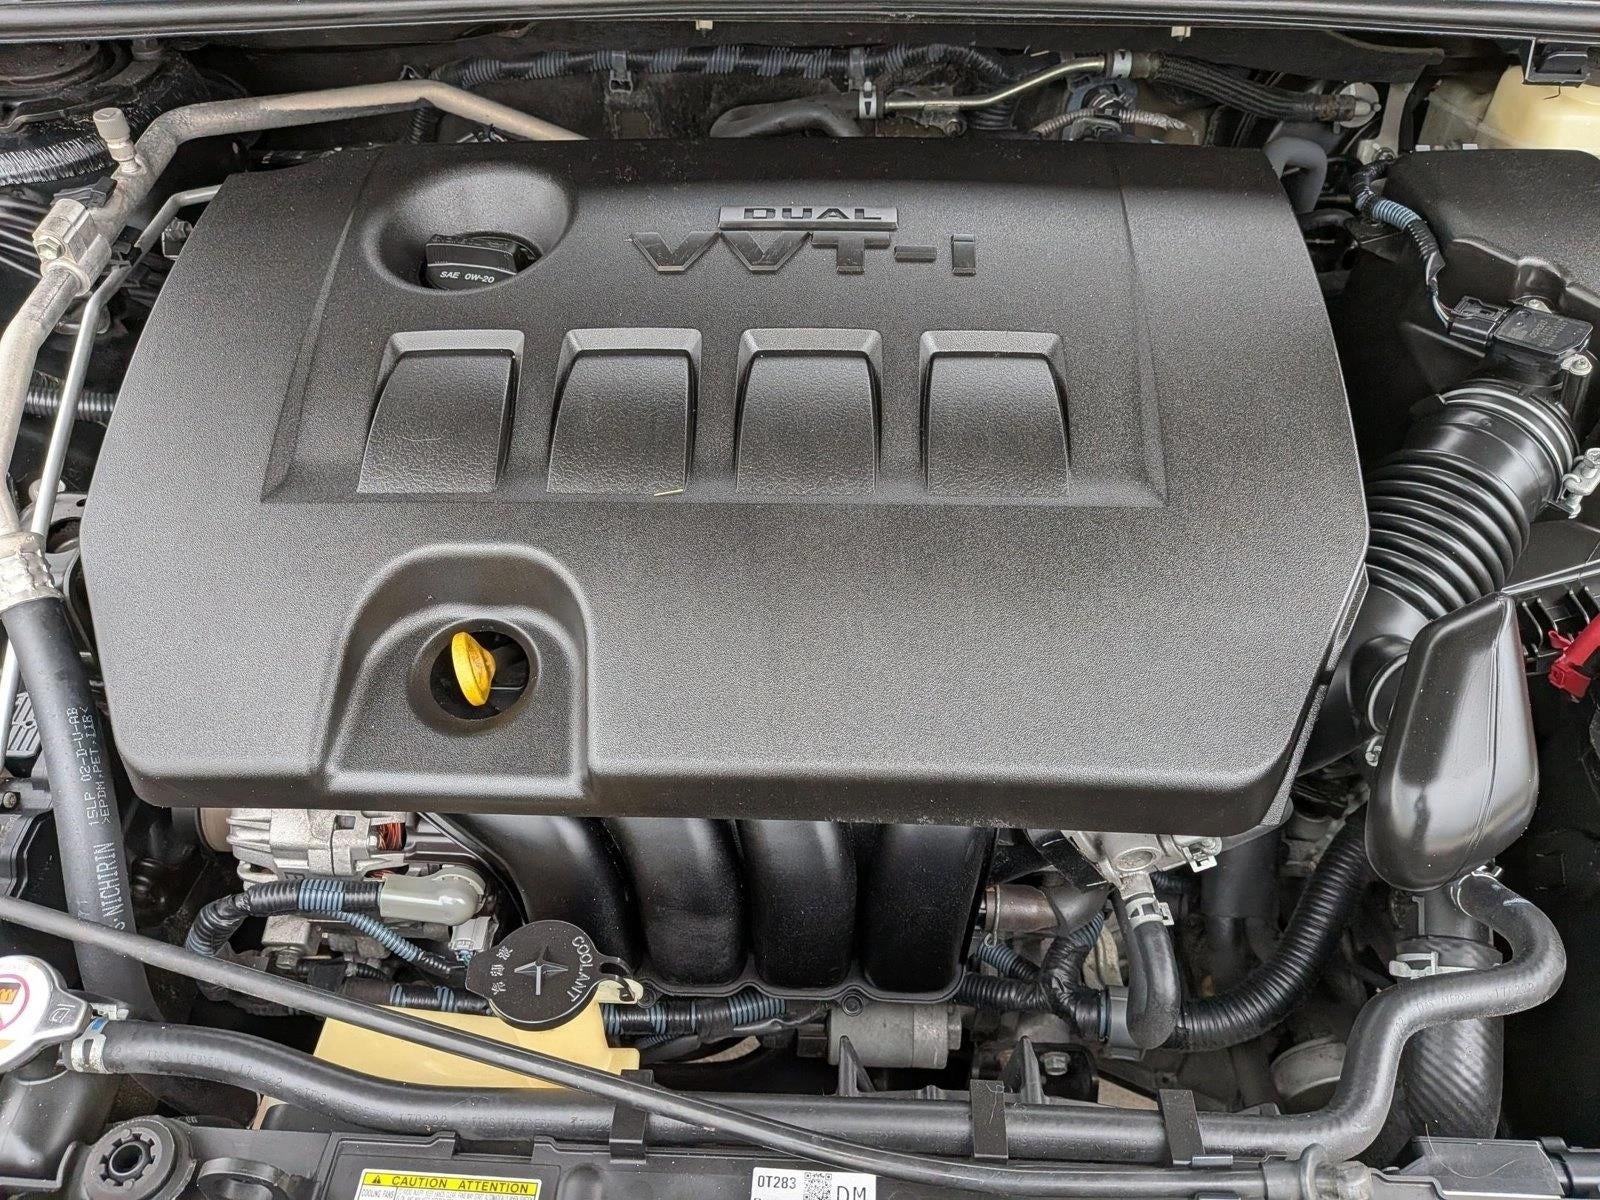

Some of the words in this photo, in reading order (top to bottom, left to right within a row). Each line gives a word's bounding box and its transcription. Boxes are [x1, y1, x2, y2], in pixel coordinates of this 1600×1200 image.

[744, 207, 882, 221] DUAL
[440, 271, 461, 279] SAE
[464, 273, 495, 284] 0W-20
[566, 936, 593, 1002] COOLANT
[391, 1176, 448, 1189] CAUTION
[457, 1180, 529, 1194] ATTENTION
[837, 1185, 867, 1200] DM
